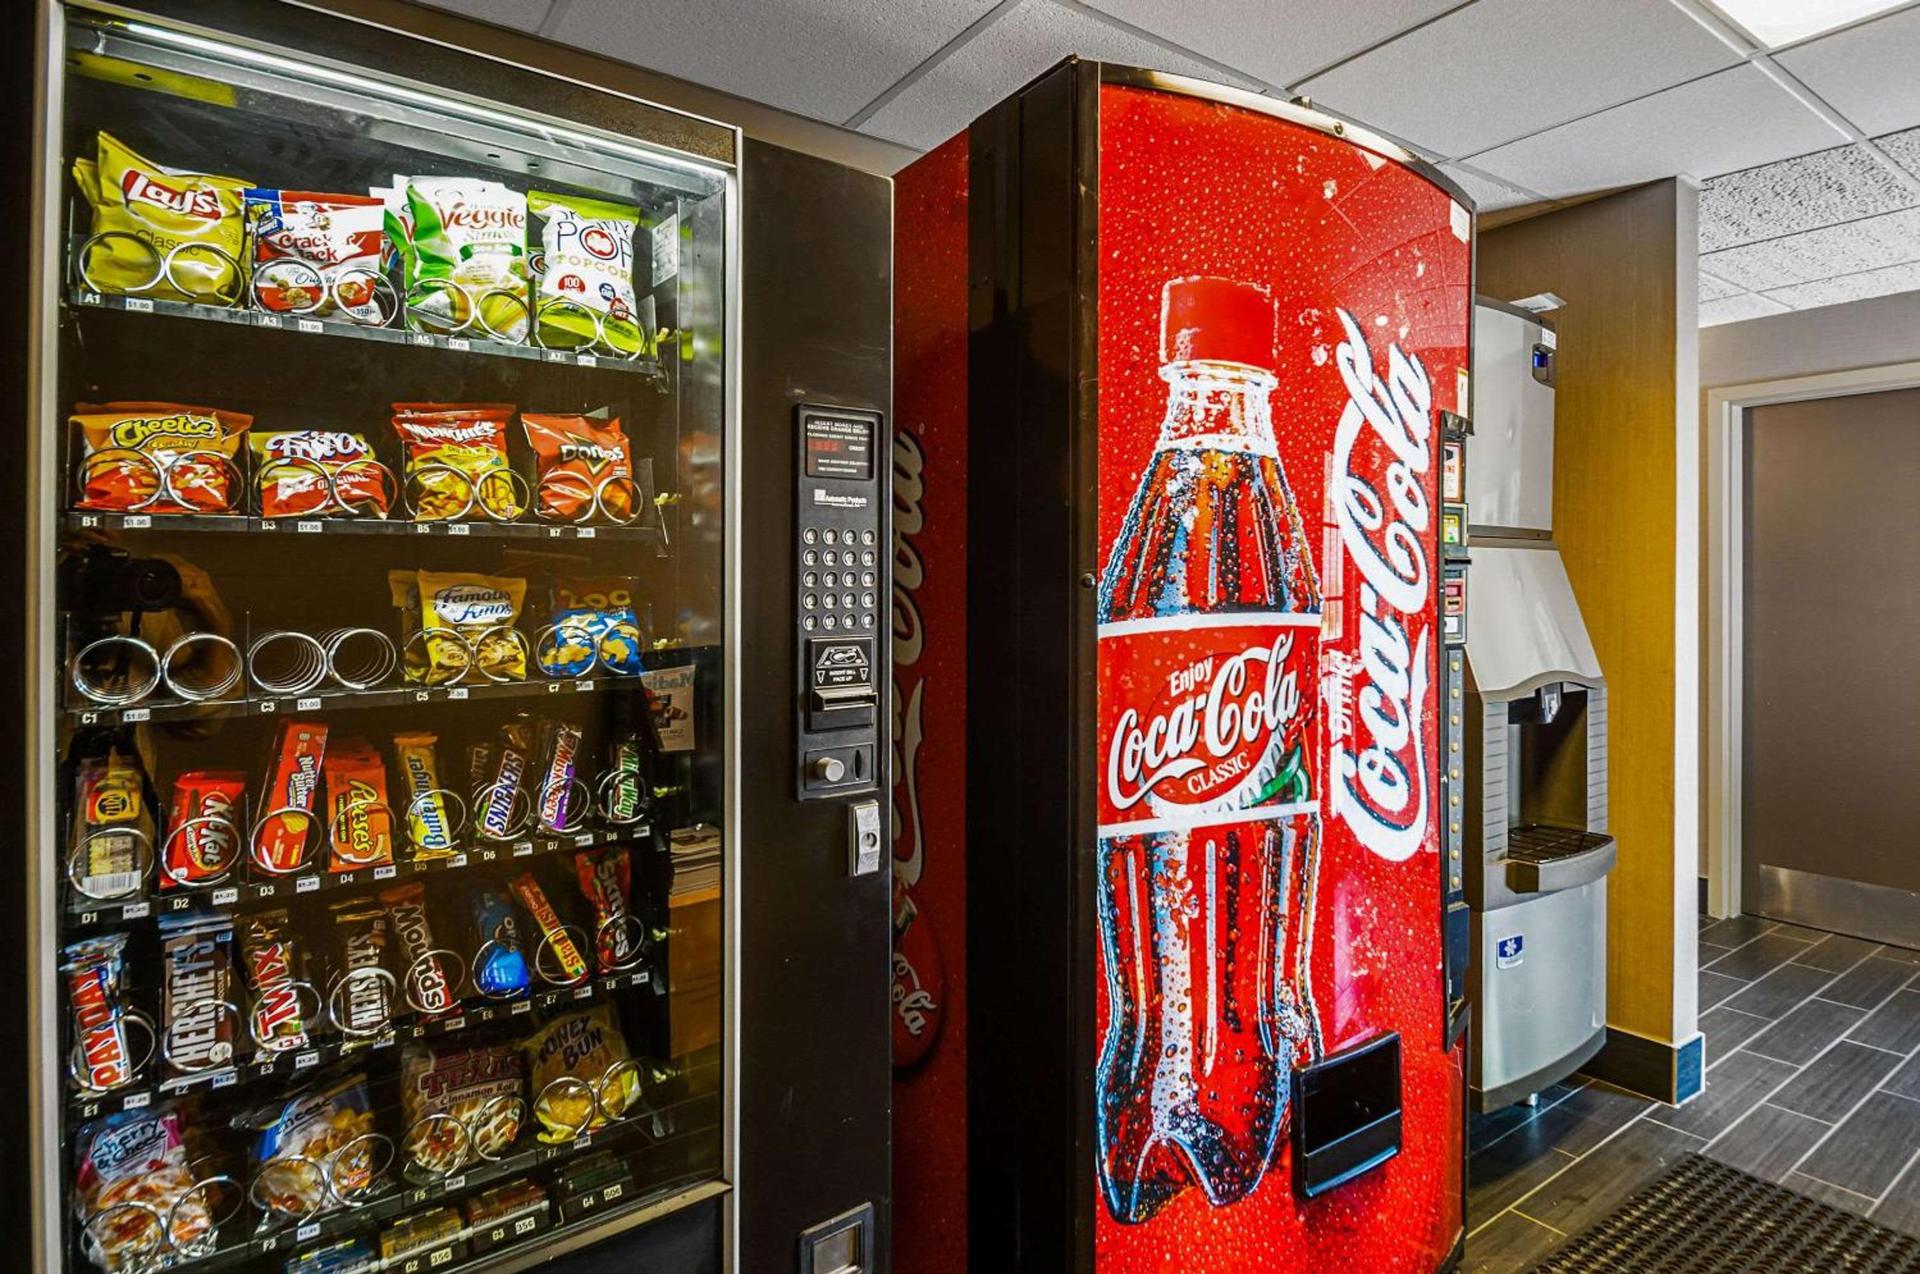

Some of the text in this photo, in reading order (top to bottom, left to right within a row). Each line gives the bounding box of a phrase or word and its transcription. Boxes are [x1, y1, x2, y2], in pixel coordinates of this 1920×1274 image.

[438, 203, 525, 231] Veggie
[302, 247, 338, 262] ack
[86, 293, 100, 304] A1
[263, 317, 277, 326] A3
[317, 474, 370, 490] OGINAL
[82, 517, 98, 527] B1
[262, 520, 276, 530] B3
[1335, 306, 1434, 863] Coca-Cola
[438, 587, 512, 604] Famous
[453, 603, 513, 623] Amos
[1170, 656, 1214, 698] Enjoy
[261, 702, 275, 713] C3
[82, 713, 97, 724] C1
[1108, 628, 1301, 812] Coca-Cola
[298, 755, 318, 790] Nutter
[1187, 751, 1252, 796] CLASSIC
[291, 772, 308, 807] Butter
[485, 750, 524, 835] SNICKERS
[407, 756, 448, 846] Butteringer
[547, 842, 558, 850] D7
[483, 851, 496, 860] D6
[340, 874, 353, 884] D4
[260, 886, 275, 896] D3
[174, 899, 188, 910] D2
[81, 912, 97, 924] D1
[547, 995, 557, 1004] E7
[71, 967, 121, 1087] PAYDAY
[413, 1027, 425, 1037] E5
[260, 1064, 274, 1075] E3
[175, 1084, 189, 1095] E2
[84, 1104, 98, 1117] E1
[90, 1118, 160, 1159] Cherry
[112, 1129, 167, 1162] Cheese
[583, 1197, 594, 1207] G4
[263, 1239, 276, 1252] F3
